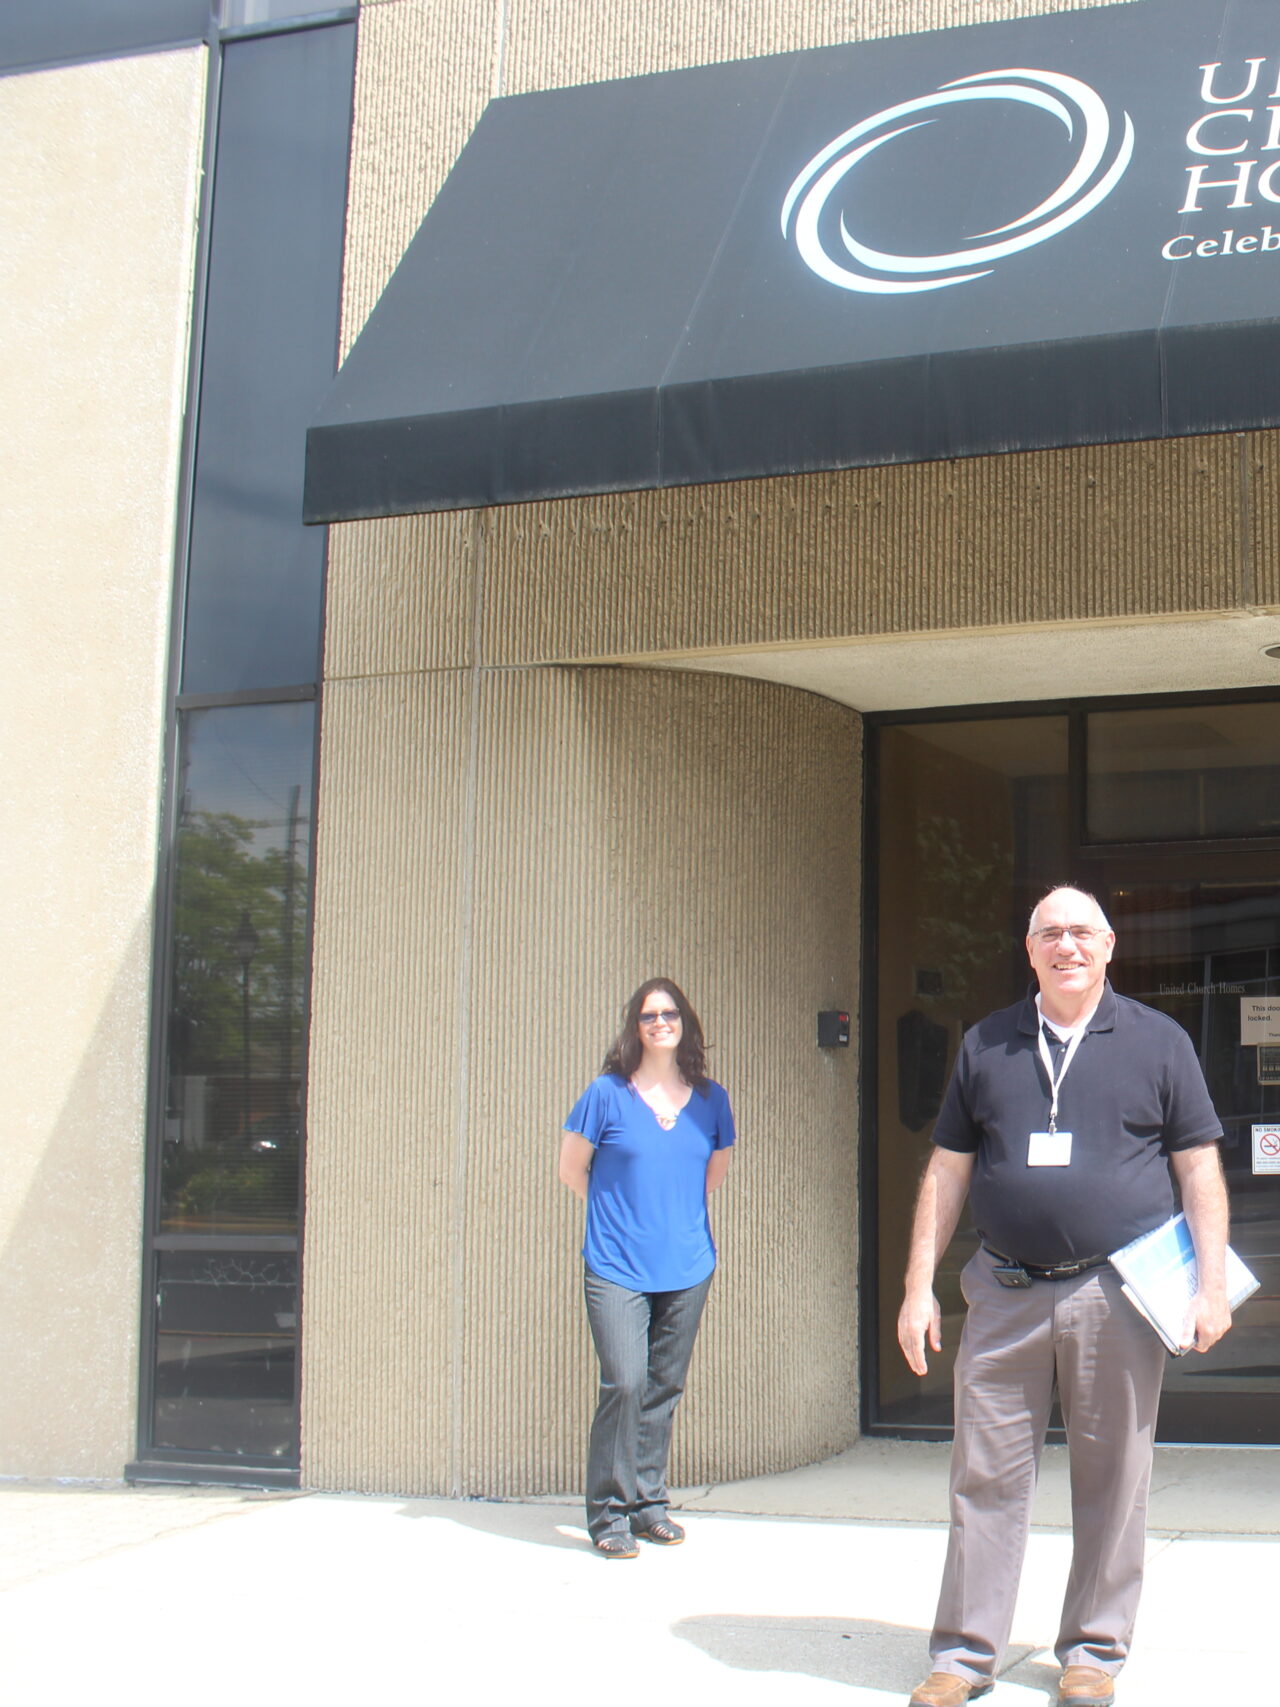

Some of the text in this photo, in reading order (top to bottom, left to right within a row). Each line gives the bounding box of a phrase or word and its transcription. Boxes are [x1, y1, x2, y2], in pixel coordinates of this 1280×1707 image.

[1159, 981, 1245, 996] United Church Homes
